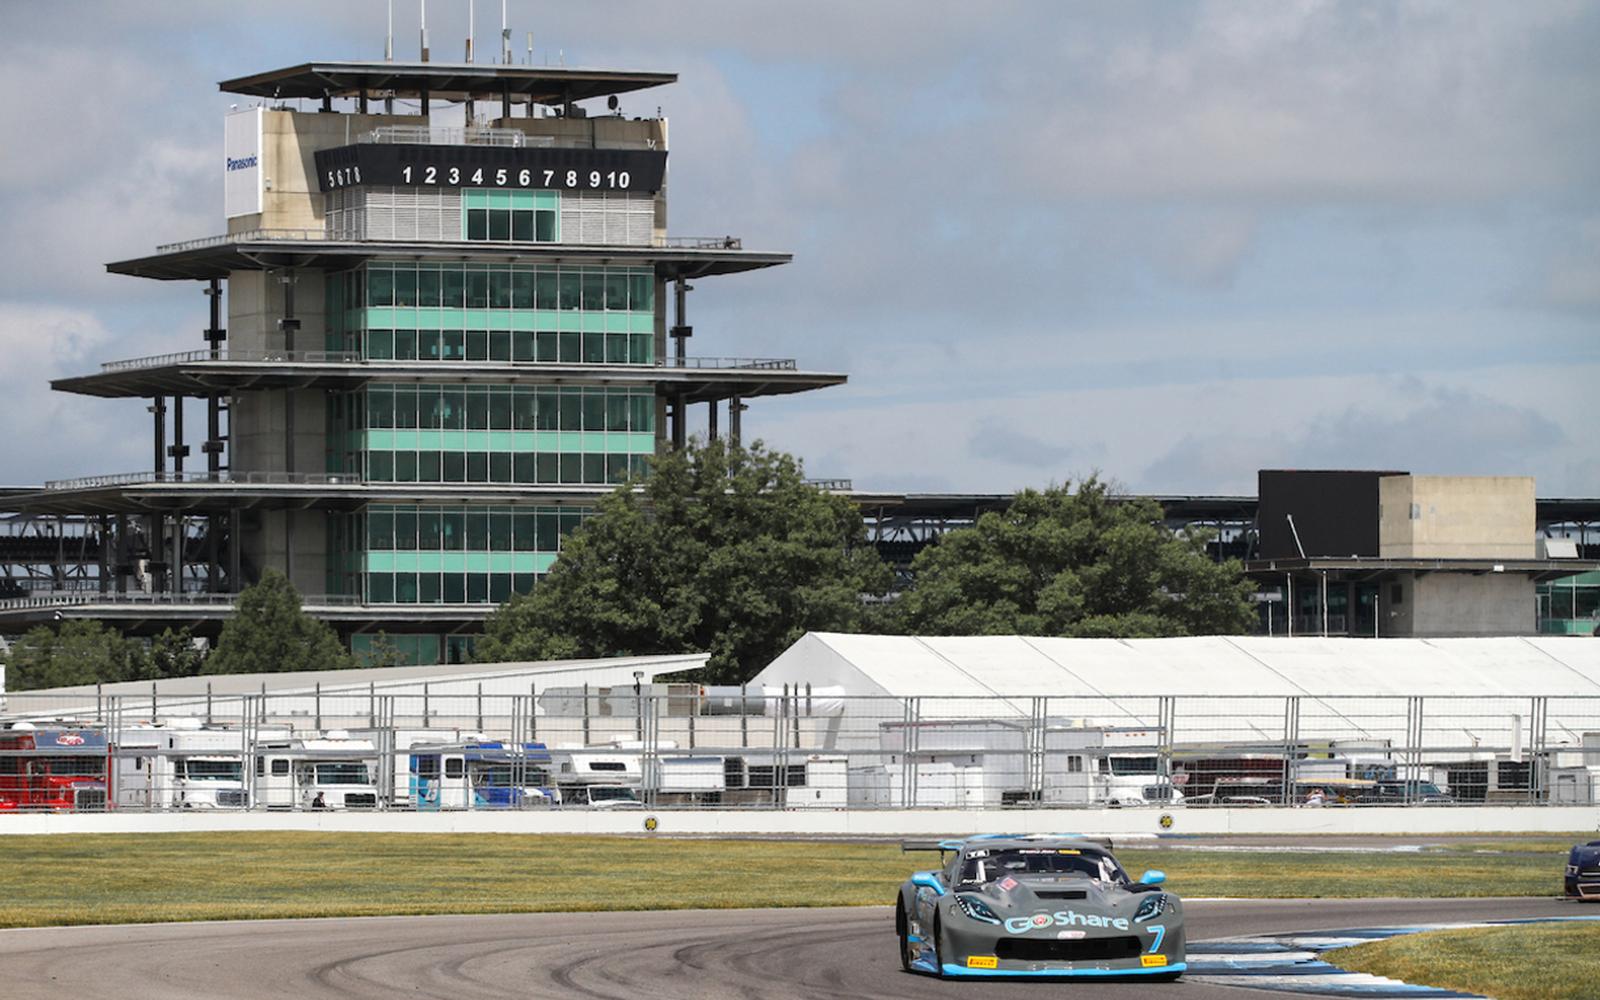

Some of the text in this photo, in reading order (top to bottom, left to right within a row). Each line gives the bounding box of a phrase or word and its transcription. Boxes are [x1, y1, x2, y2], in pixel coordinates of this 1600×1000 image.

[227, 156, 257, 171] Panasonic
[402, 166, 630, 189] 1 2 3 4 5 6 7 8 9 10
[1146, 925, 1166, 954] 7
